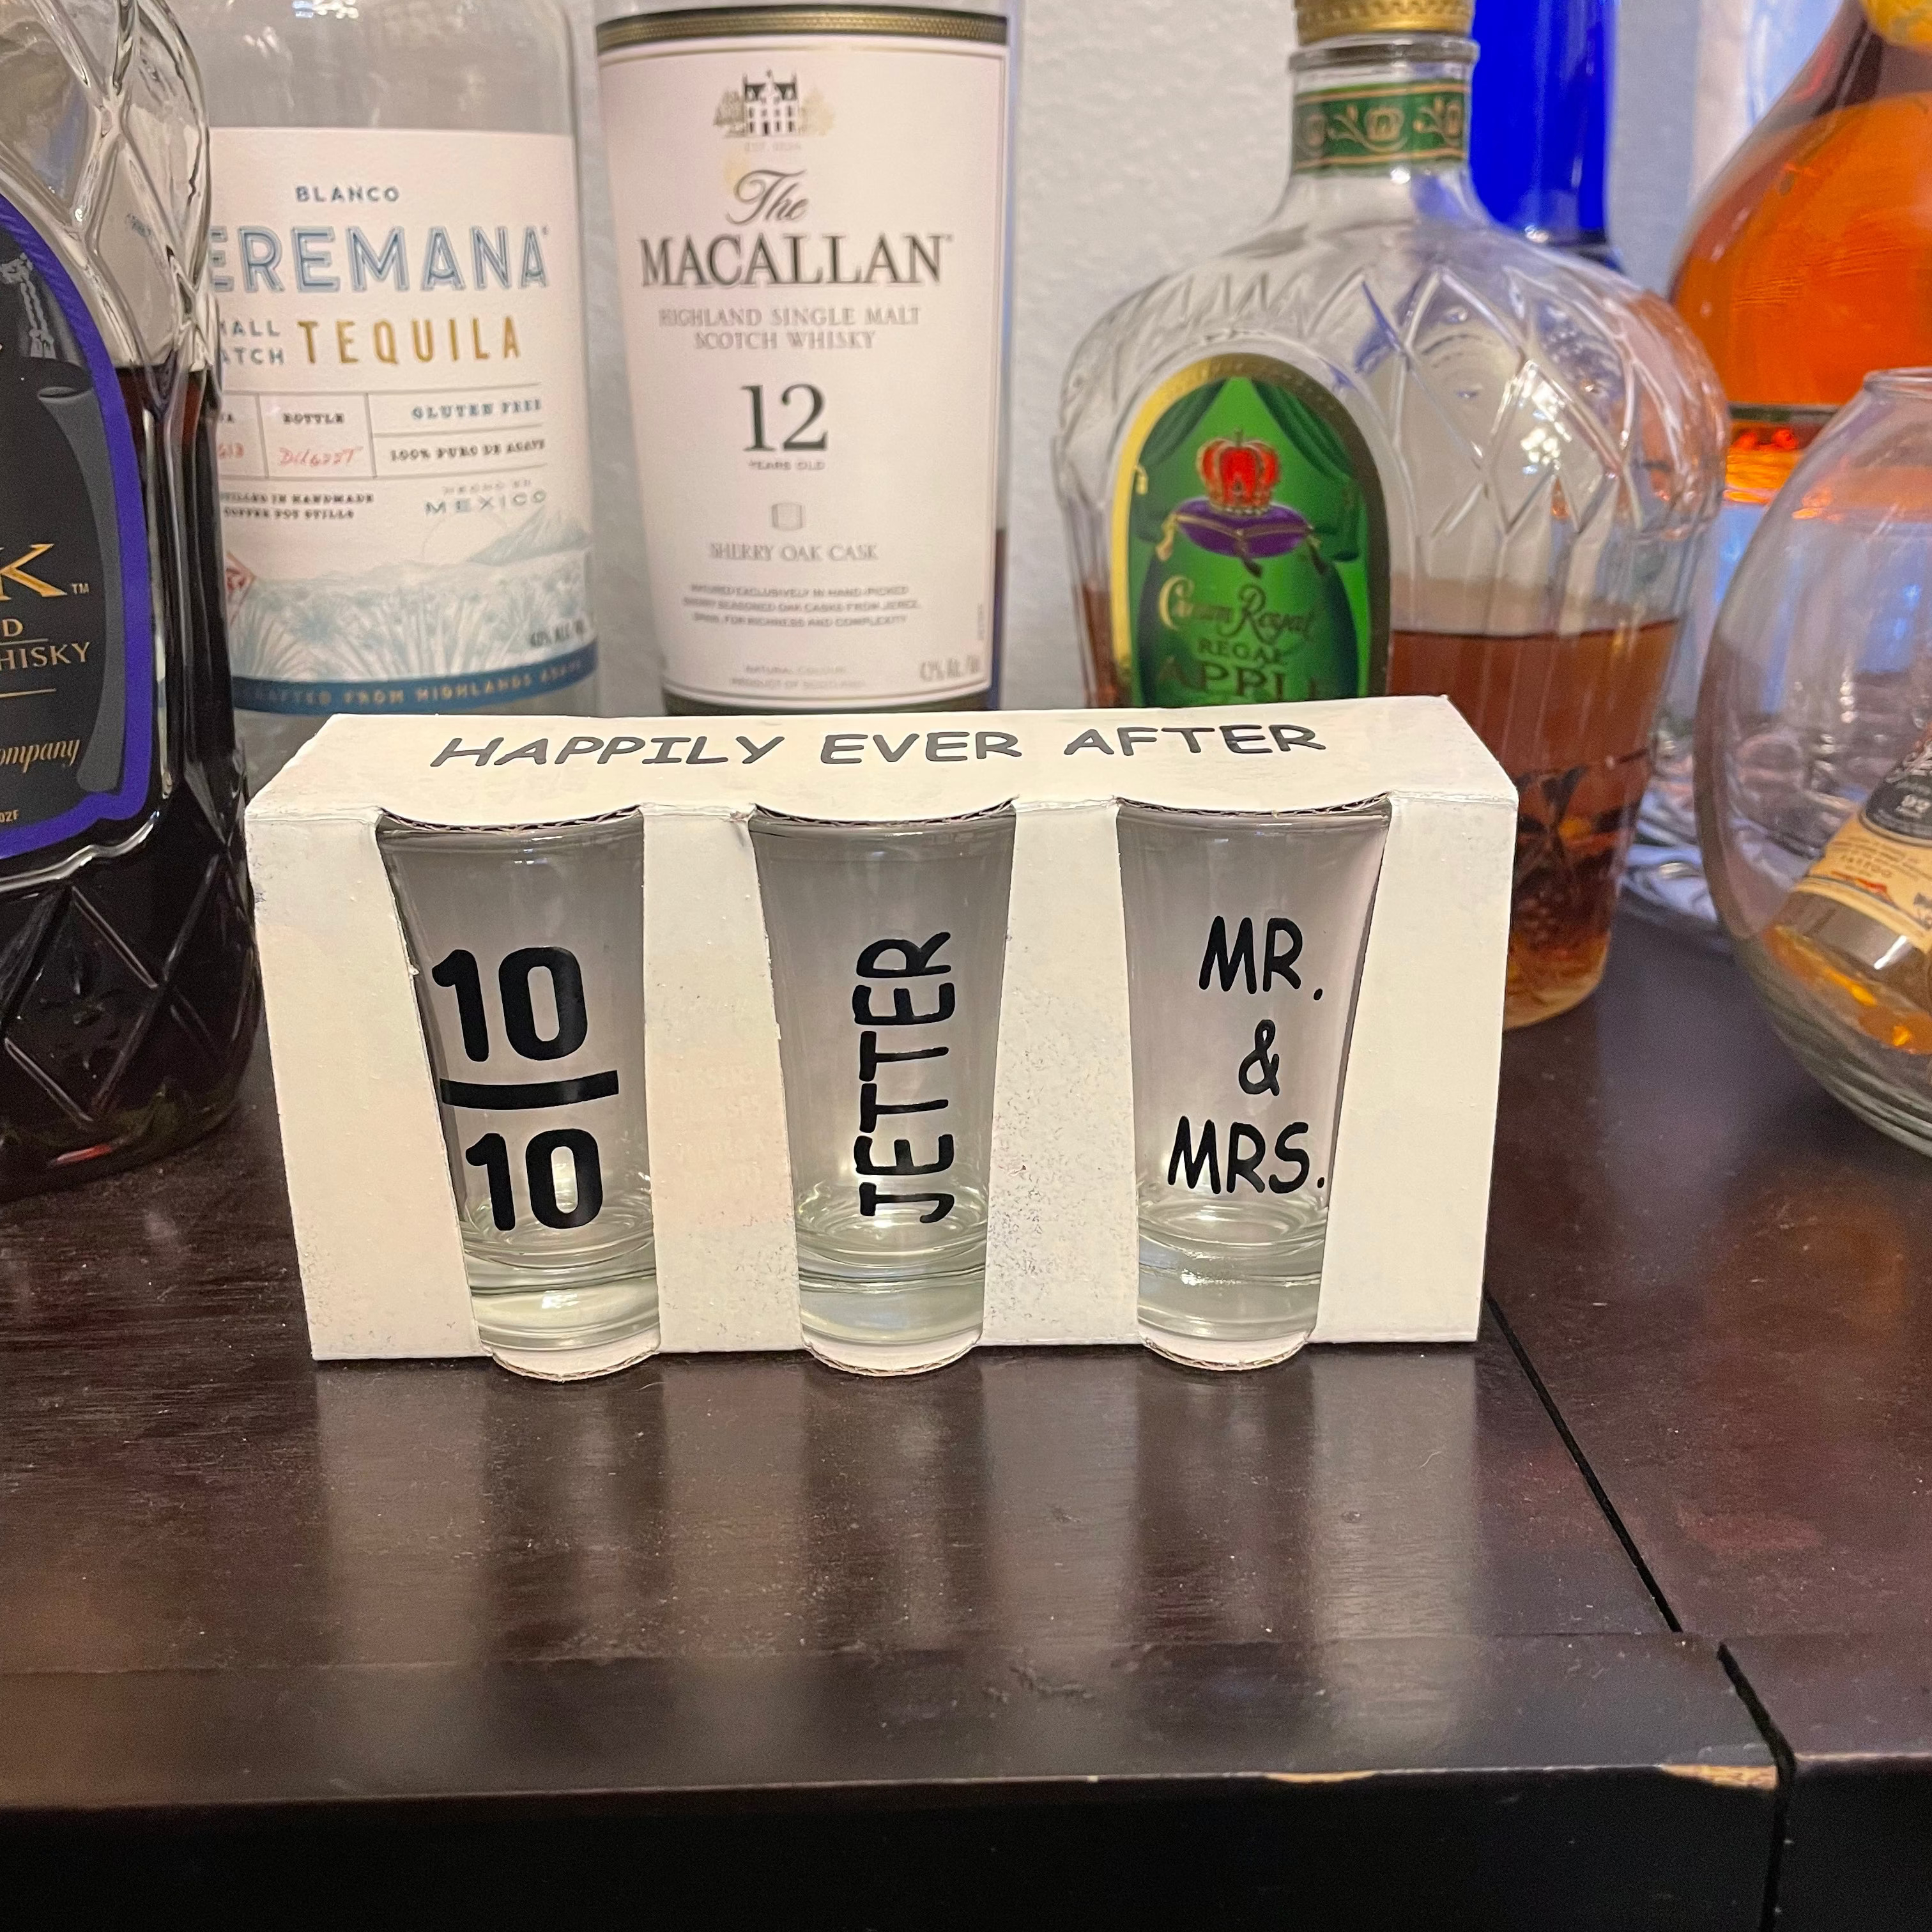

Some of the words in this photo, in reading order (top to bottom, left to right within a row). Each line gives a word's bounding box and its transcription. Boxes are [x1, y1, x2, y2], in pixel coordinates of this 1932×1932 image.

[295, 185, 400, 203] BLANCO
[724, 167, 809, 226] The
[210, 224, 549, 293] EREMANA
[639, 232, 944, 288] MACALLAN
[297, 315, 521, 365] TEQUILA
[659, 307, 762, 328] HIGHLAND
[772, 306, 855, 326] SINGLE
[866, 305, 920, 325] MALT
[694, 331, 778, 350] SCOTCH
[786, 330, 876, 349] WHISKY
[216, 347, 284, 365] ATCH
[412, 402, 493, 420] GLUTEN
[740, 383, 829, 452] 12
[424, 489, 546, 515] MEXICO
[780, 543, 822, 562] OAK
[830, 542, 878, 560] CASK
[0, 641, 90, 671] HISKY
[0, 739, 80, 773] ompany
[430, 735, 786, 767] HAPPILY
[820, 731, 1023, 765] EVER
[1063, 723, 1327, 757] AFTER
[1198, 915, 1324, 1001] MR.
[431, 946, 588, 1062] 10
[852, 931, 956, 1224] JETTER
[1238, 1018, 1280, 1096] &
[465, 1128, 604, 1232] 10
[1167, 1115, 1326, 1195] MRS.
